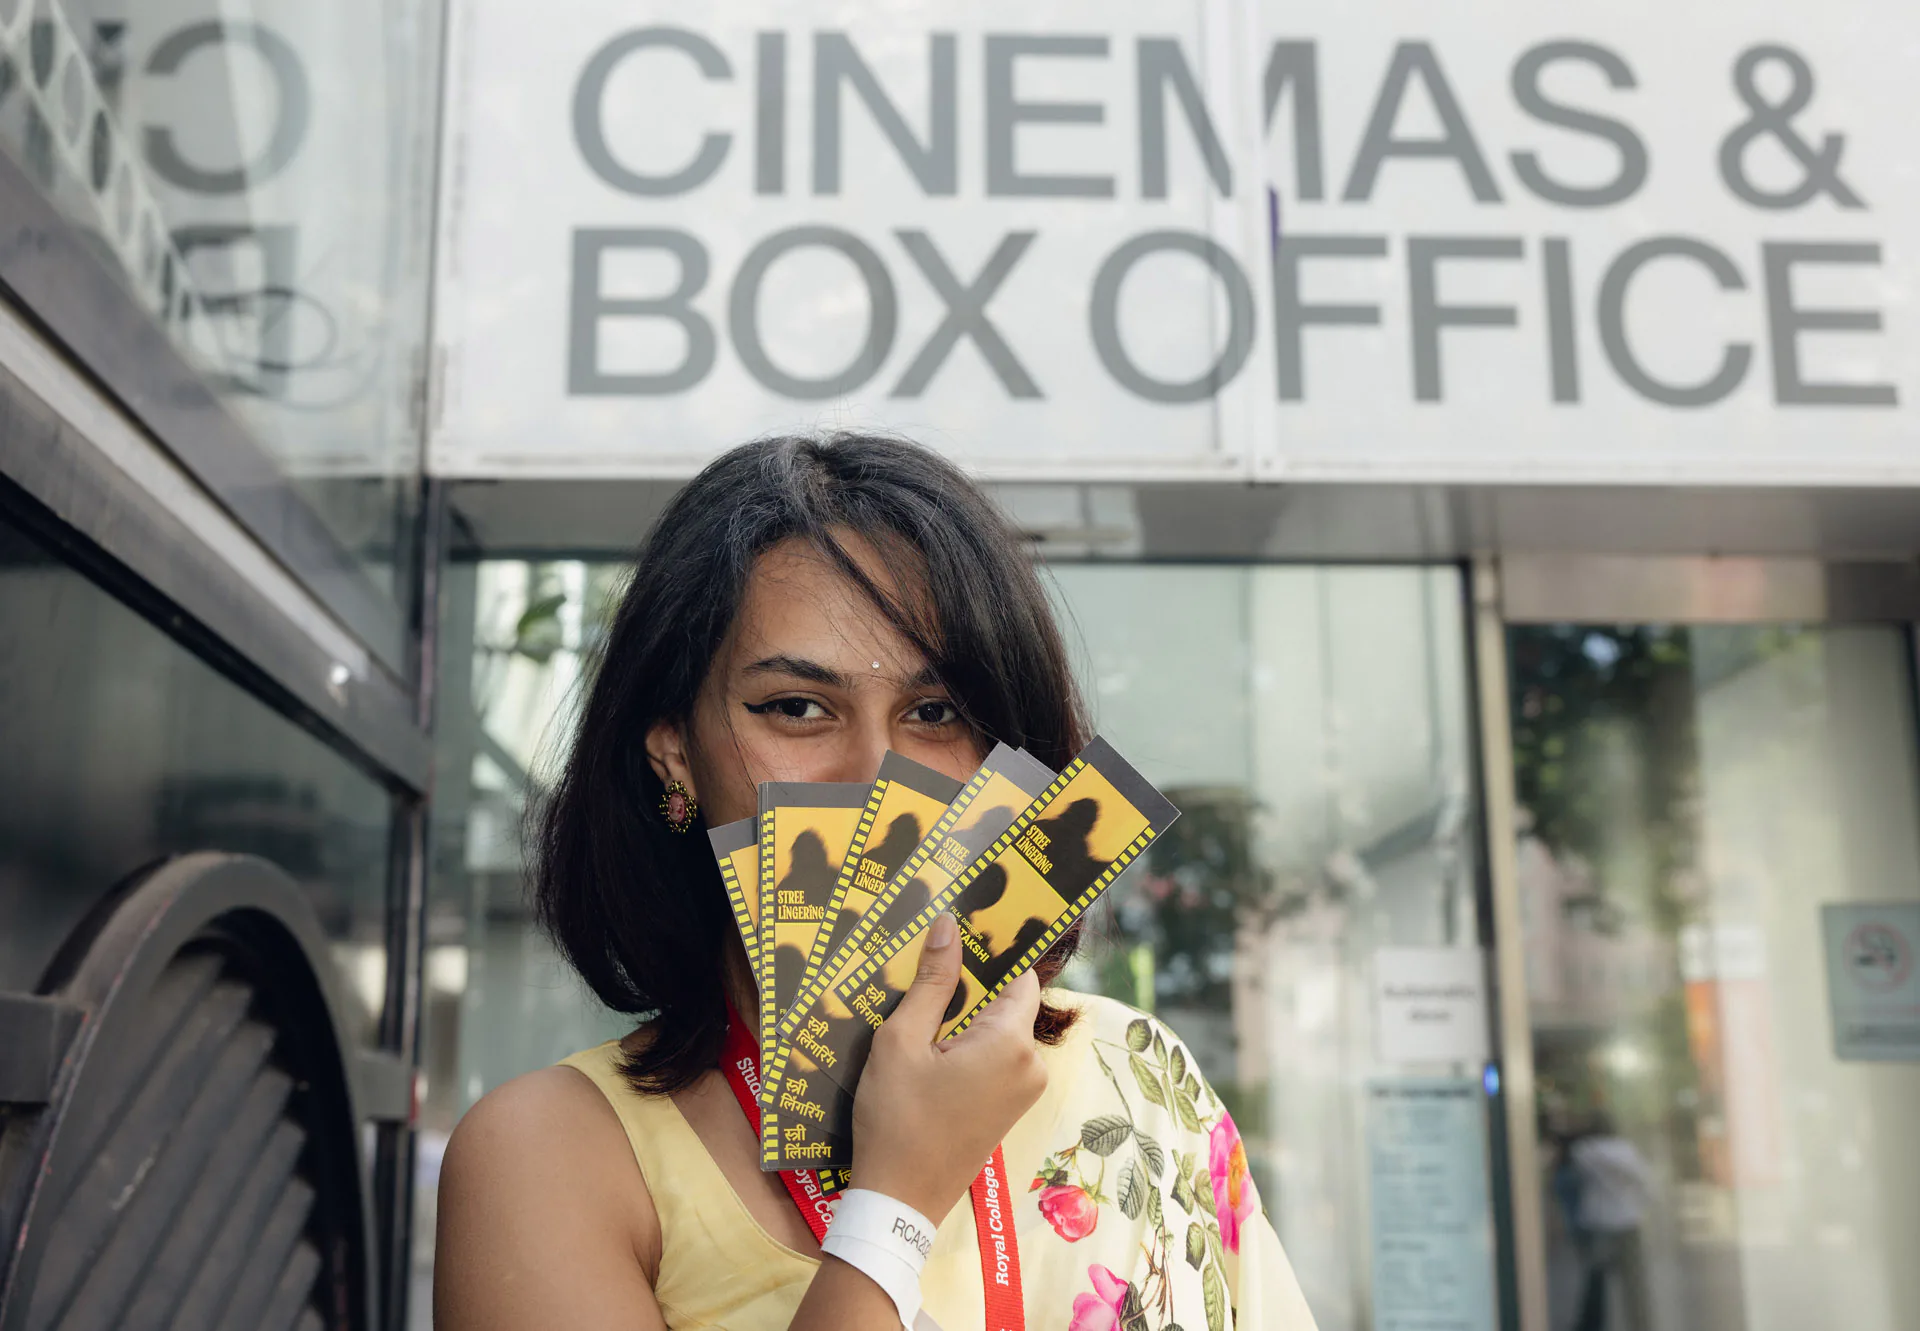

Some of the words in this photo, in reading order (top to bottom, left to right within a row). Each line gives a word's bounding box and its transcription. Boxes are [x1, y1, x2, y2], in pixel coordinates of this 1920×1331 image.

[570, 24, 1651, 210] CINEMAS
[1716, 42, 1870, 211] &
[565, 224, 1045, 401] BOX
[1088, 228, 1900, 409] OFFICE
[942, 836, 970, 861] STREE
[1026, 824, 1051, 851] STREE
[860, 857, 887, 880] STREE
[933, 848, 967, 876] LINGER
[1015, 835, 1054, 875] LINGERING
[777, 890, 805, 904] STREE
[854, 871, 888, 894] LINGER
[950, 905, 962, 918] FILM
[961, 917, 984, 941] DIRECTOR
[870, 932, 887, 946] SH
[958, 924, 990, 963] TAKSHI
[795, 1169, 822, 1200] oyal
[984, 1166, 1003, 1232] College
[991, 1233, 1010, 1286] Royal
